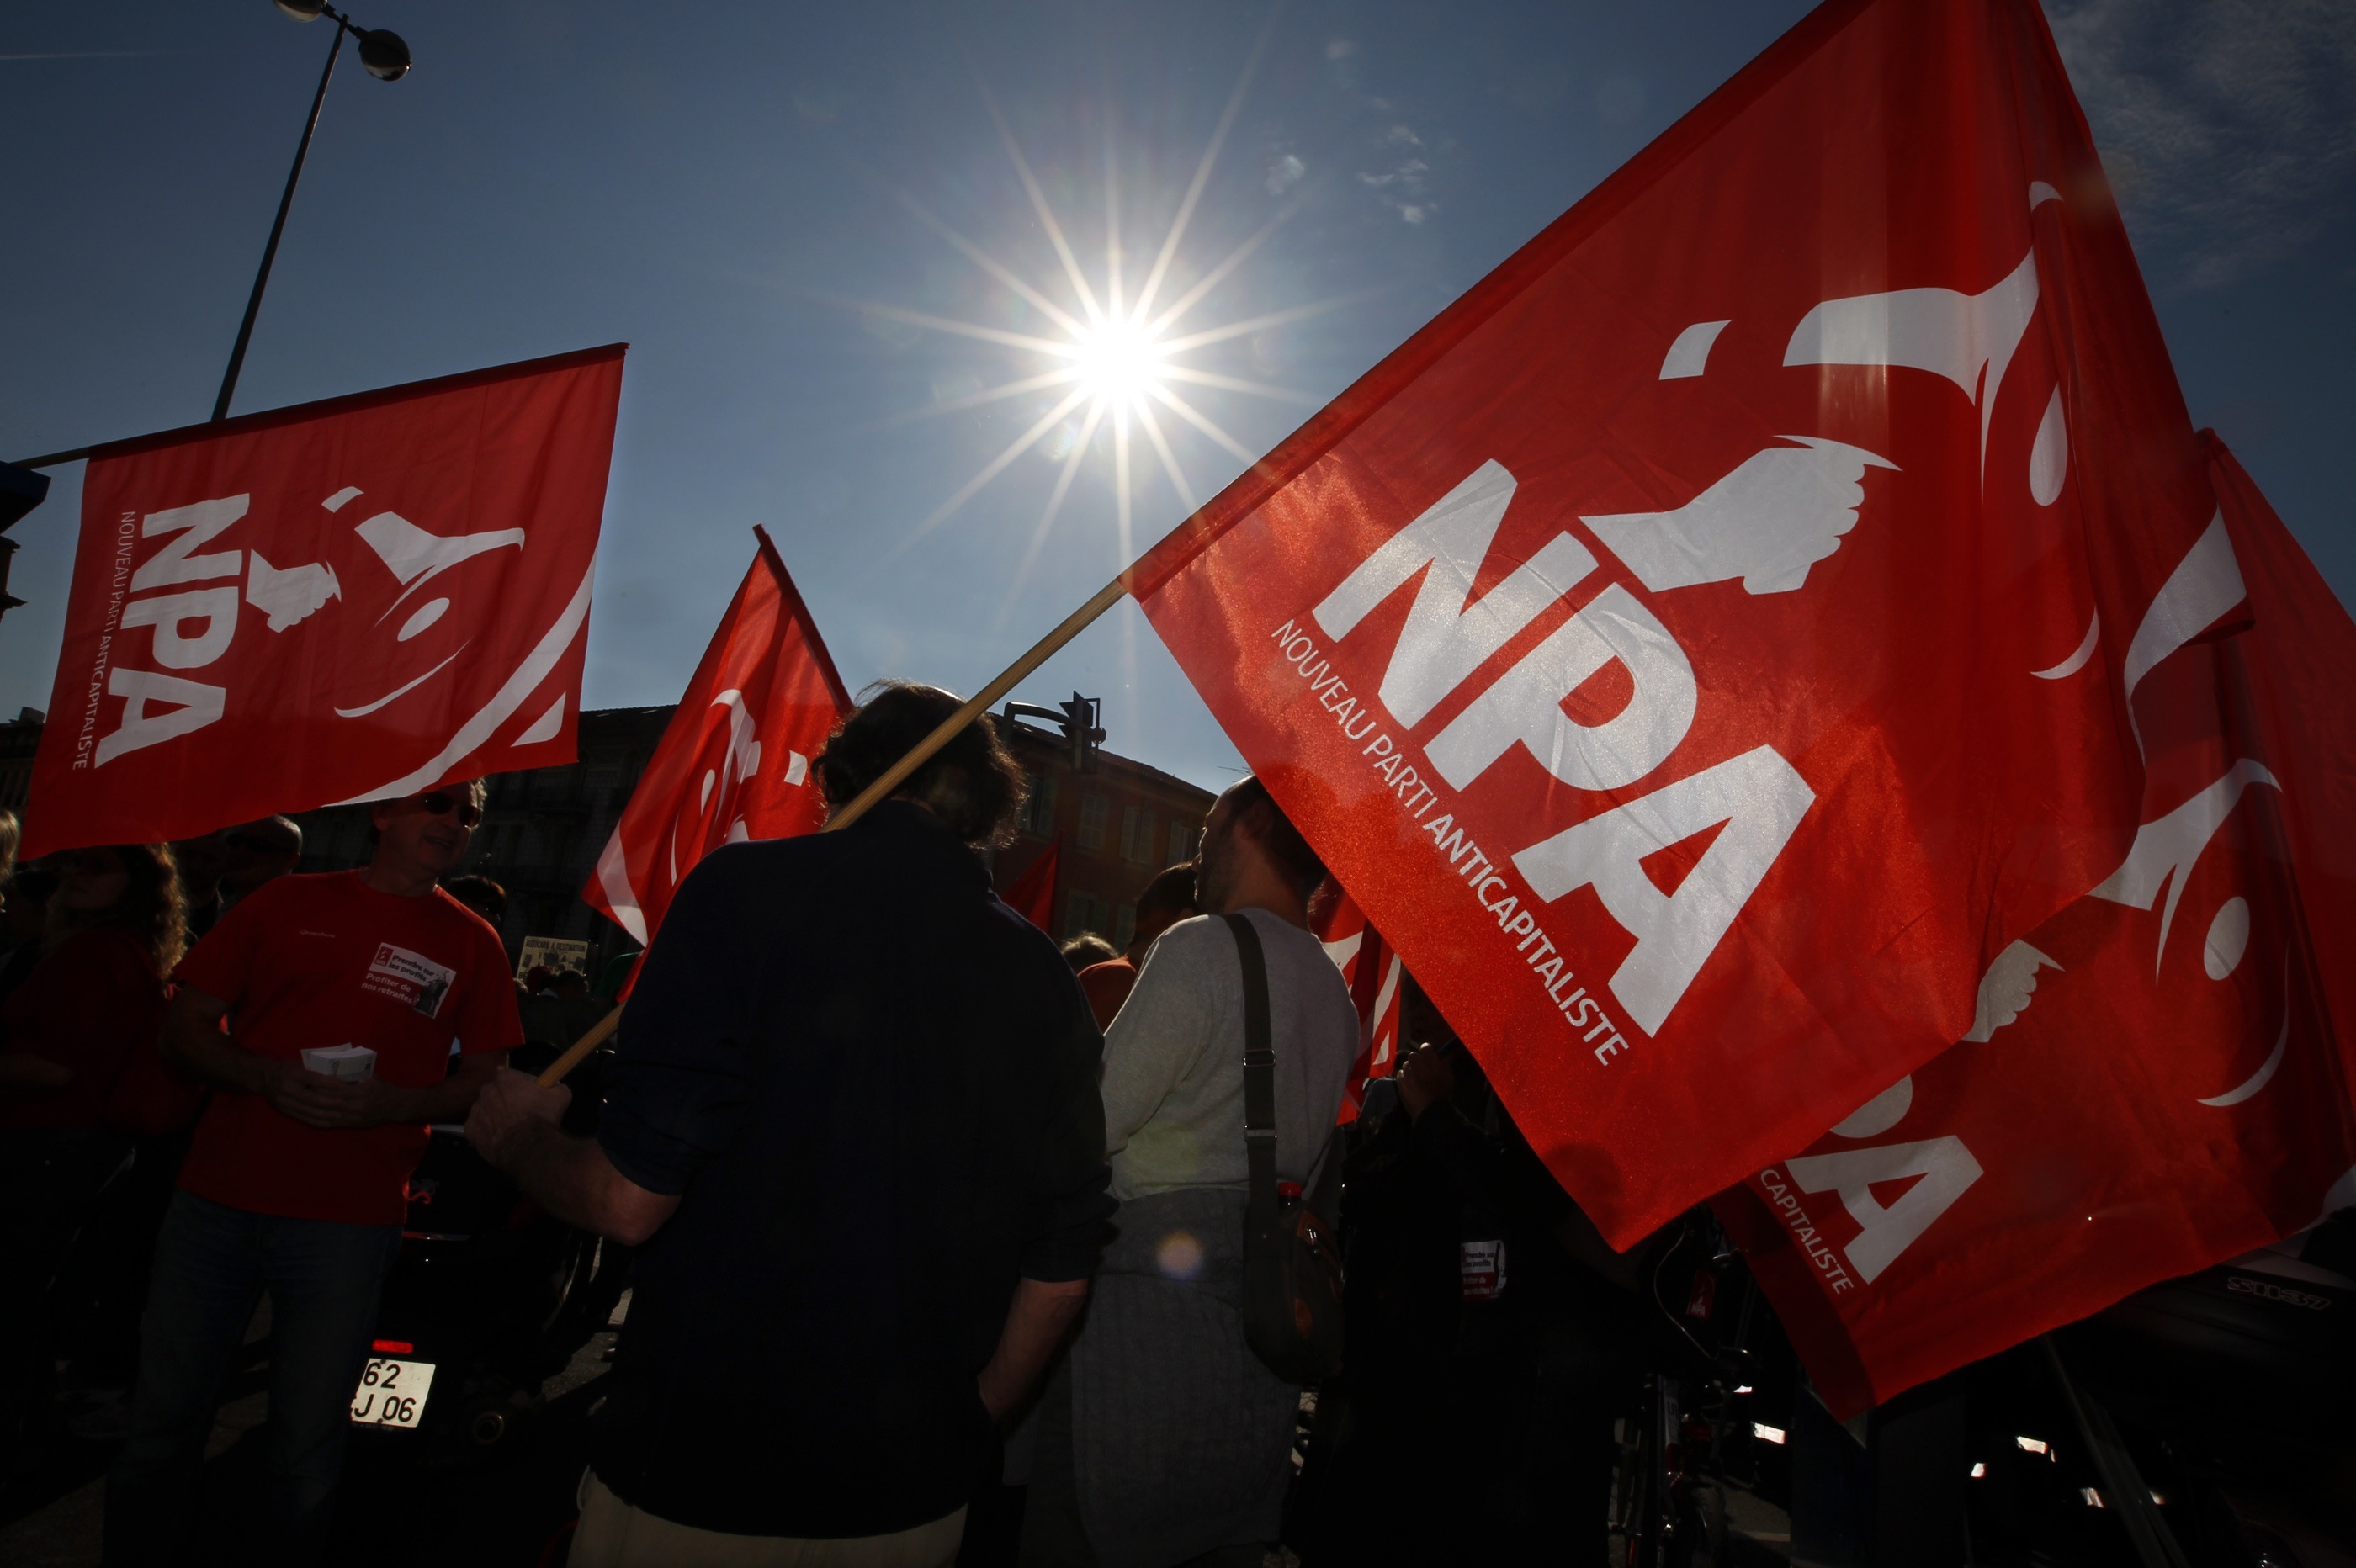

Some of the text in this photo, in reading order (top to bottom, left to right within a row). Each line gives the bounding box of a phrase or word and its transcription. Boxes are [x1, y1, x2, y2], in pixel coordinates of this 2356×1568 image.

[72, 511, 135, 771] NOUVEAU PARTI ANTICAPITALISTE
[94, 492, 250, 770] NPA
[1312, 458, 1817, 1039] NPA
[1271, 619, 1630, 1067] NOUVEAU PARTI ANTICAPITALISTE
[388, 961, 400, 970] les
[400, 966, 427, 981] profits
[391, 955, 422, 971] Prendre
[423, 967, 435, 977] sur
[361, 983, 377, 991] nos
[378, 987, 413, 1004] retraites
[365, 972, 411, 993] Profiter de
[1760, 1168, 1854, 1295] CAPITALISTE
[1691, 1302, 1706, 1316] NPA
[363, 1362, 401, 1389] 62
[350, 1394, 416, 1422] J 06
